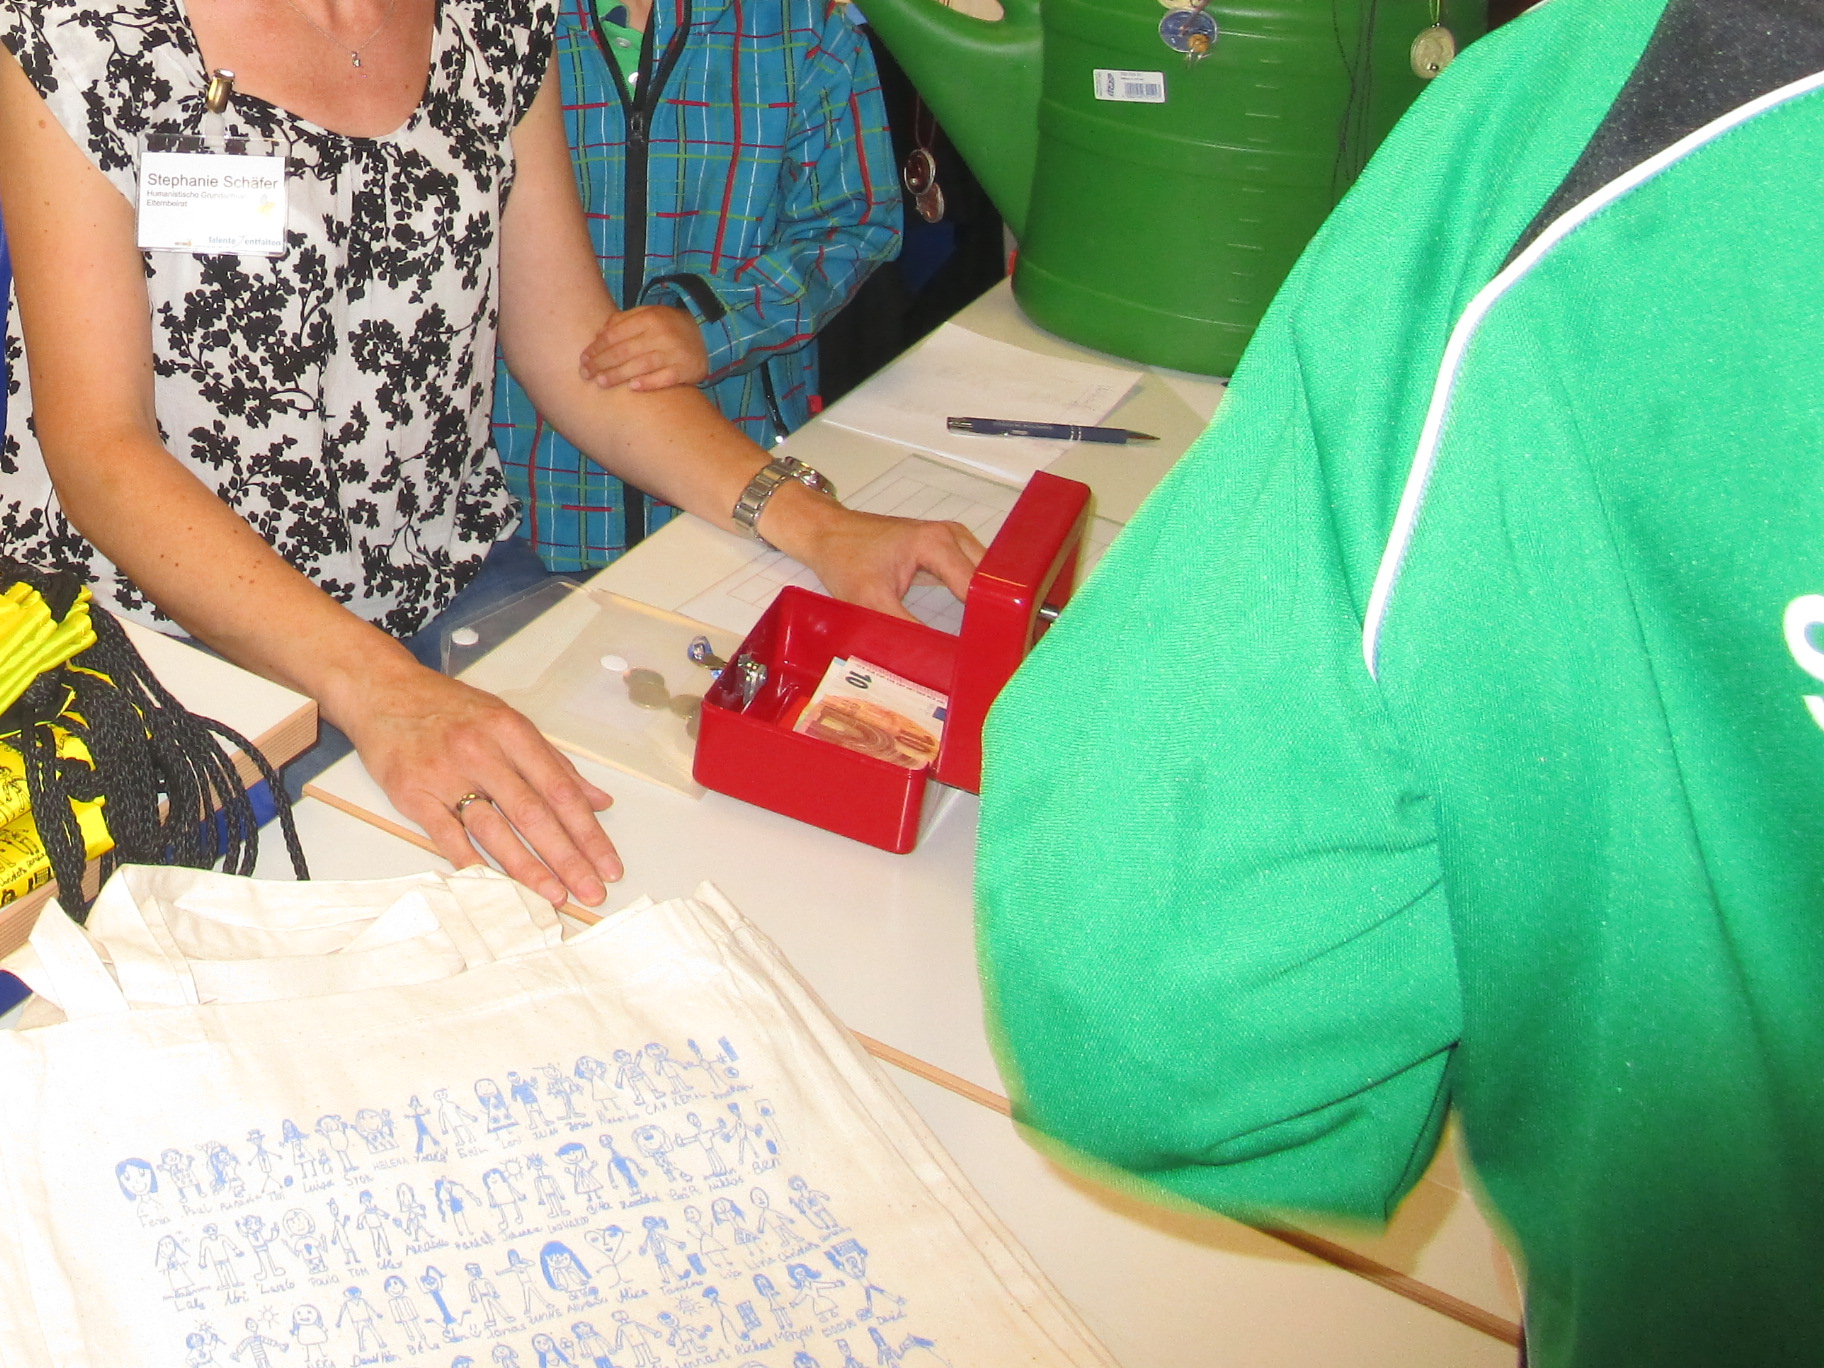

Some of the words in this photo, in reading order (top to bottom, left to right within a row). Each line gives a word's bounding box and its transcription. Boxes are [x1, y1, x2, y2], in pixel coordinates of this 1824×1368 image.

[148, 173, 218, 189] Stephanie
[223, 175, 278, 190] Schäfer
[844, 669, 873, 690] 10
